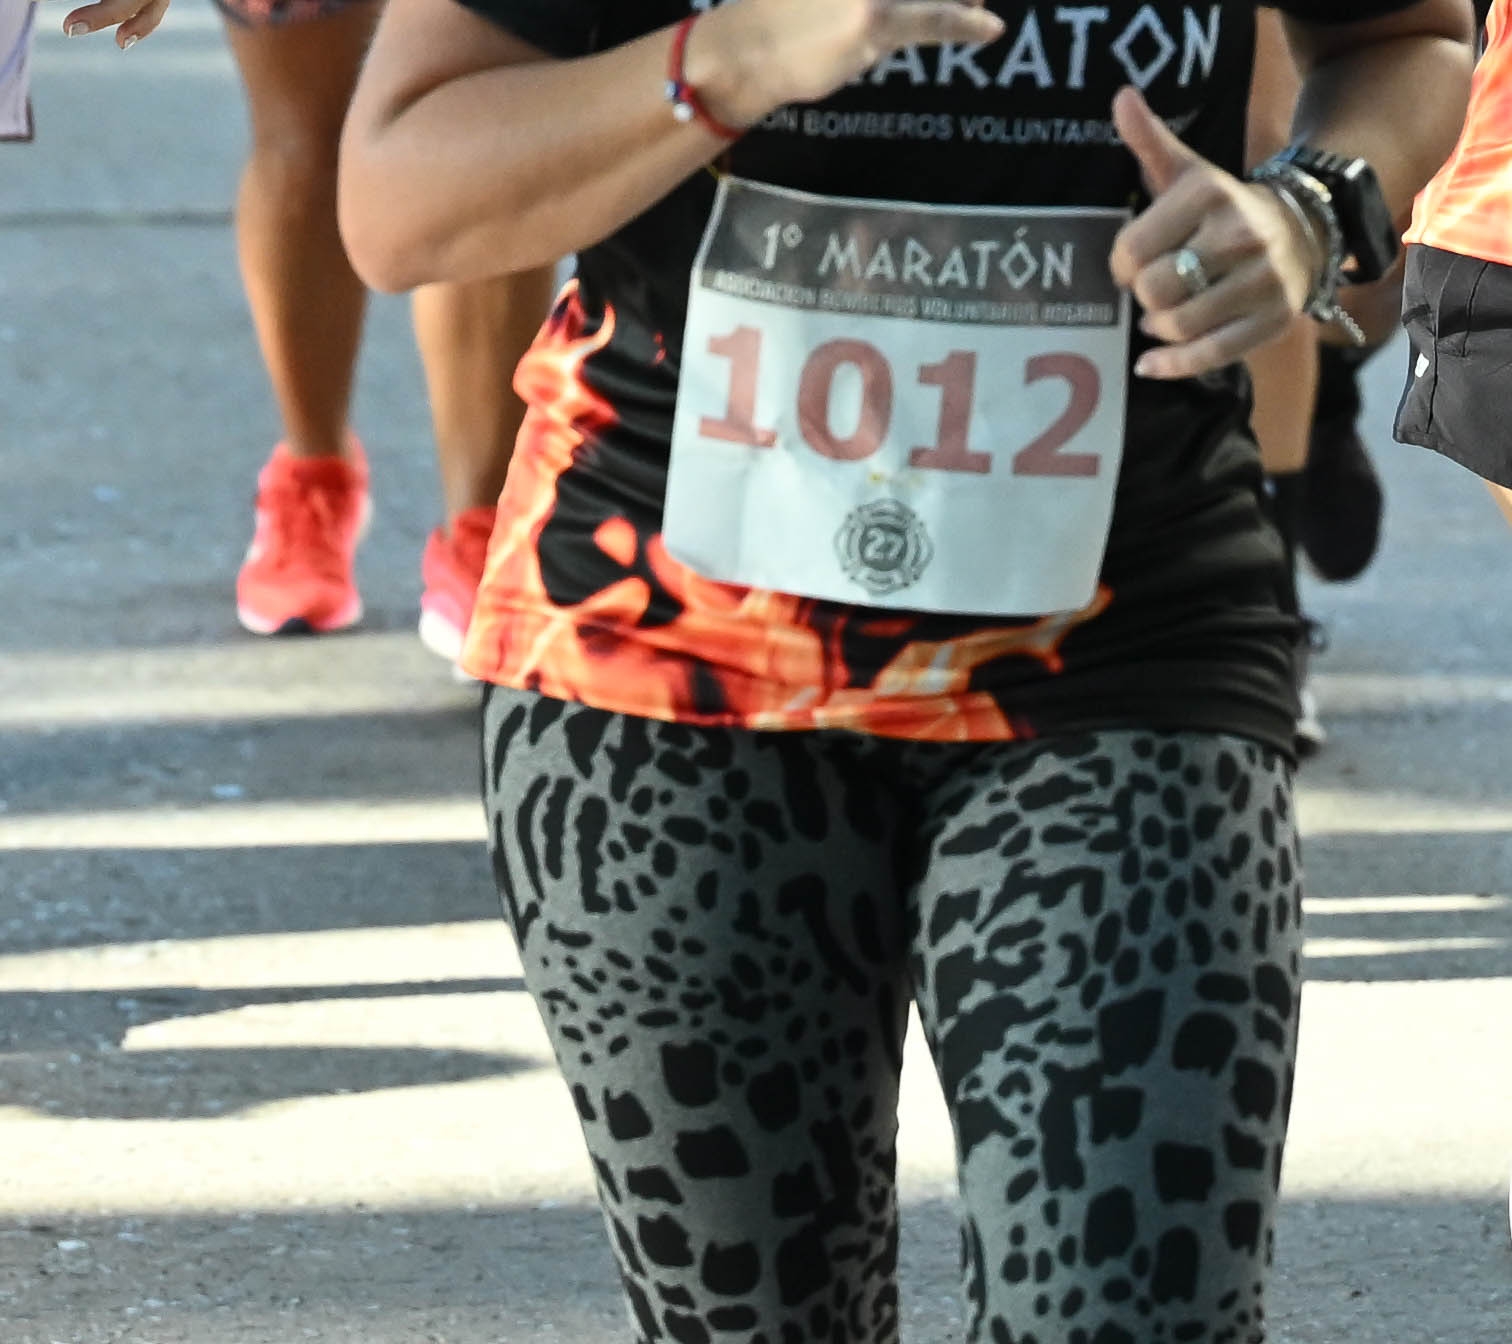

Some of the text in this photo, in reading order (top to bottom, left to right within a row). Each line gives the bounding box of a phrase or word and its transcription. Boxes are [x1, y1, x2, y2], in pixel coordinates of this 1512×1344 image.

[960, 113, 1123, 145] VOLUNTARIO
[760, 222, 1076, 290] 1° MARATÓN
[697, 324, 1103, 479] 1012
[864, 527, 904, 561] 27
